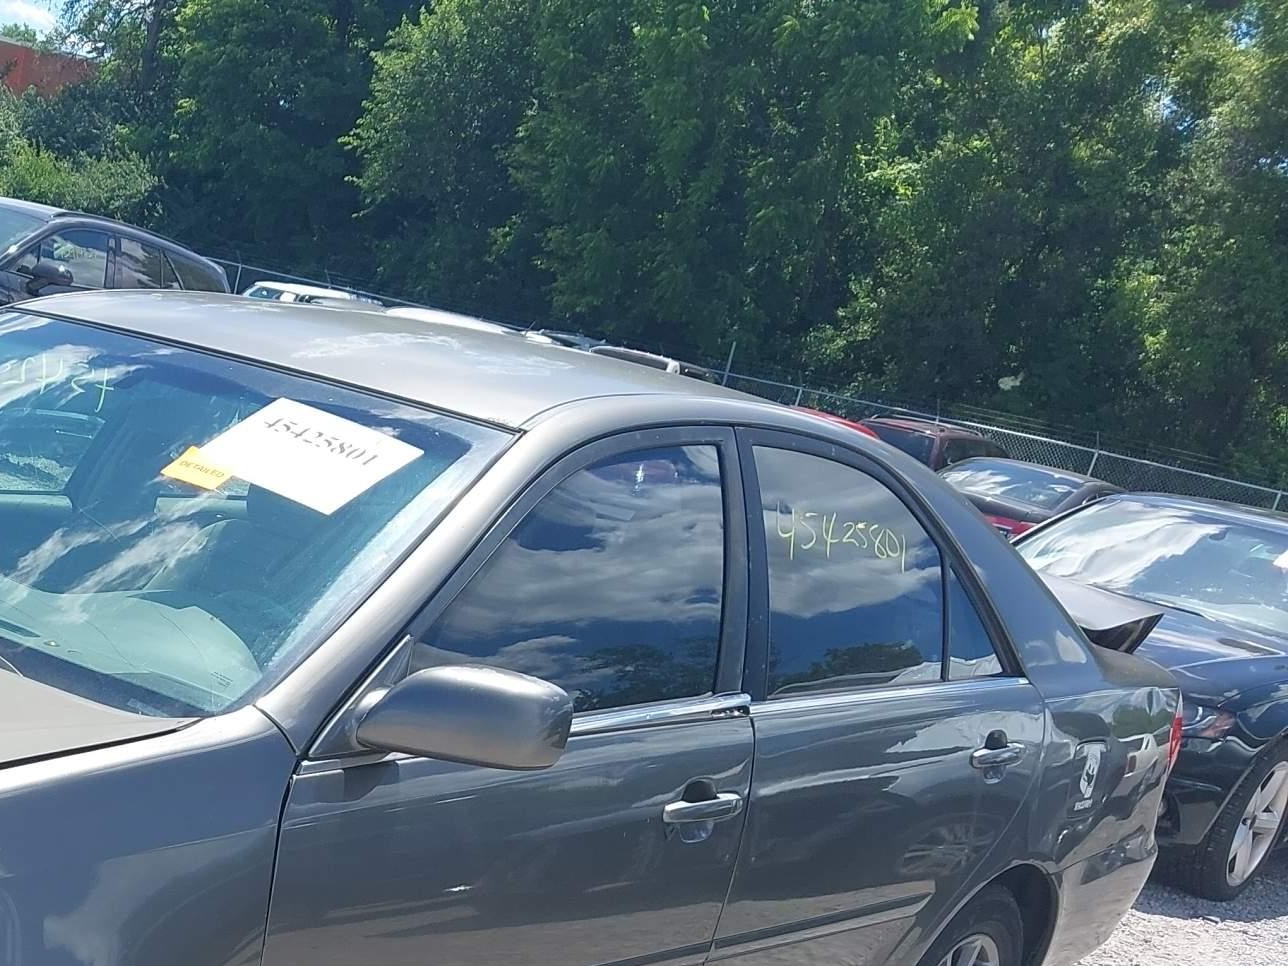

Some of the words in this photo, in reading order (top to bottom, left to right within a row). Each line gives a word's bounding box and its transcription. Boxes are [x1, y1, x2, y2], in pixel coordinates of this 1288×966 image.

[264, 417, 379, 467] 45425801
[179, 459, 225, 479] DETAILED
[776, 499, 906, 575] 45425801
